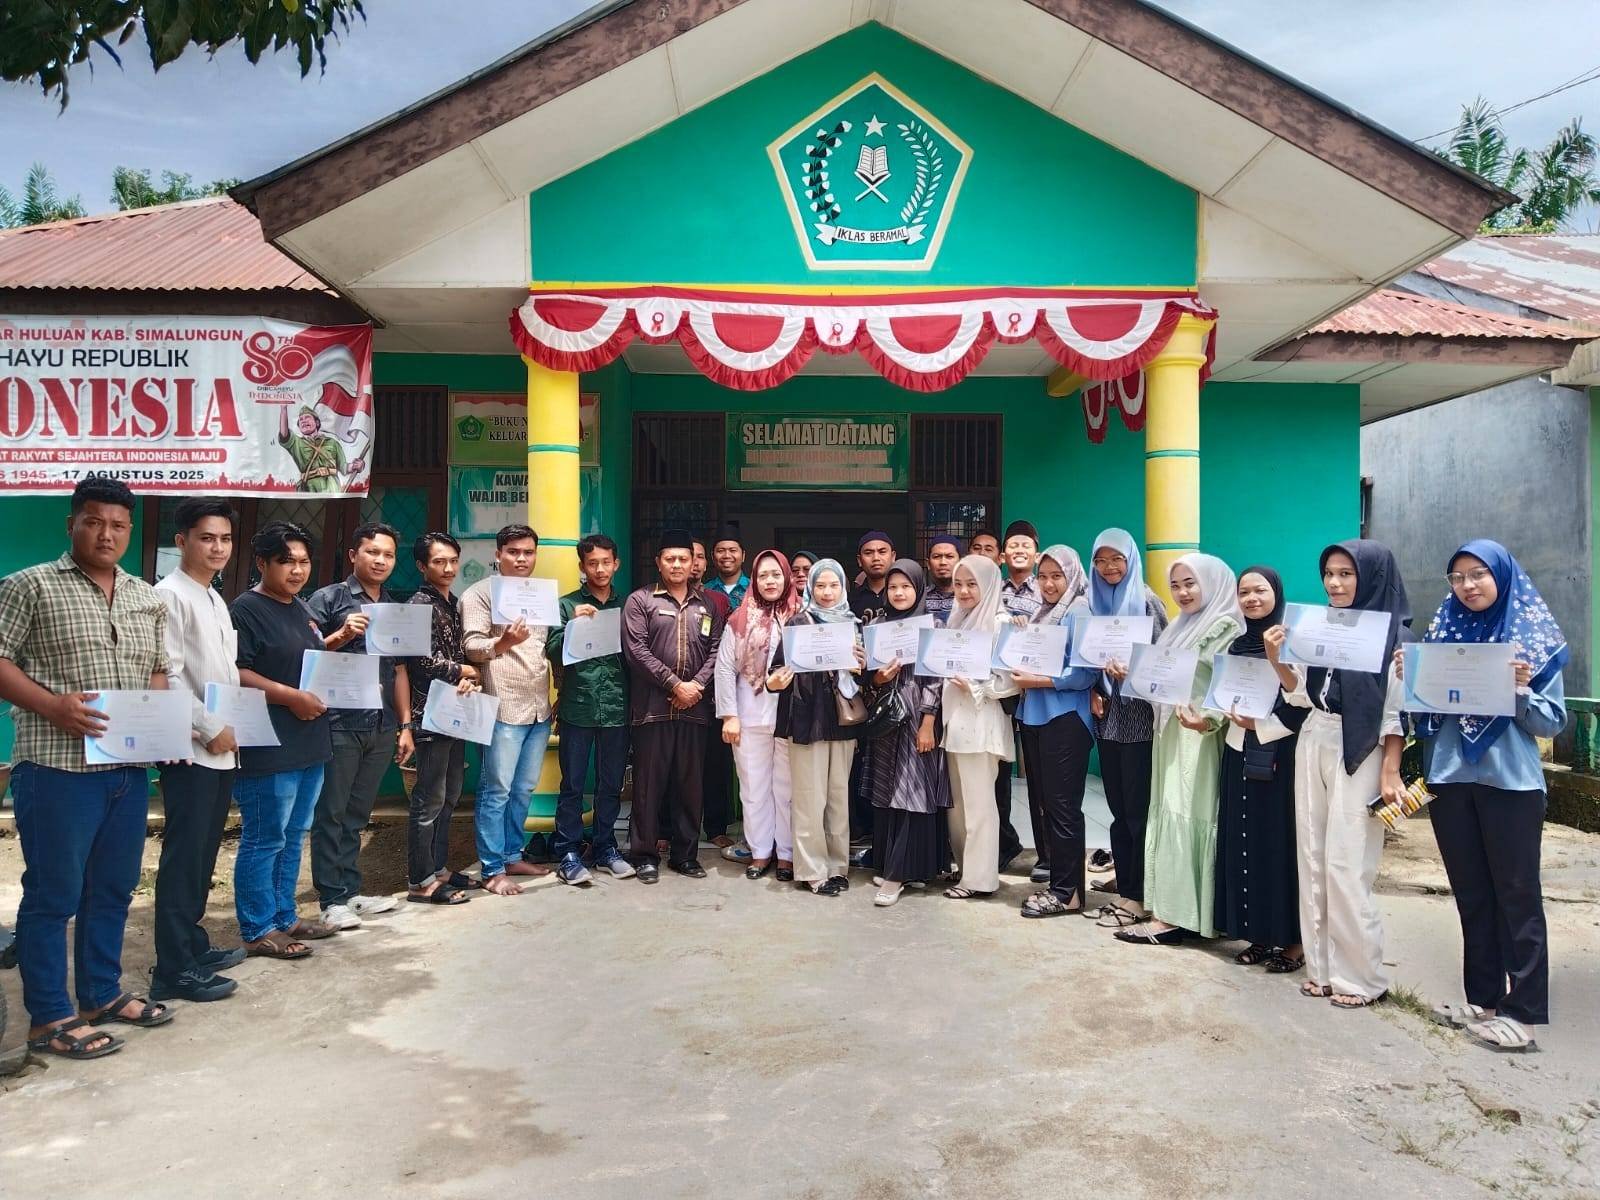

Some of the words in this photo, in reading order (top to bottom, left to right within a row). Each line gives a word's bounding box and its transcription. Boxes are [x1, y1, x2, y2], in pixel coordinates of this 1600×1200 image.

[837, 228, 866, 241] IKLAS
[870, 229, 907, 242] BERAMAL
[19, 328, 86, 341] HULUAN
[91, 329, 130, 341] KAB.
[135, 329, 244, 341] SIMALUNGUN
[277, 336, 293, 344] TH
[0, 348, 64, 368] HAYU
[71, 348, 190, 368] REPUBLIK
[242, 331, 314, 385] 80
[742, 422, 823, 446] SELAMAT
[825, 422, 896, 446] DATANG
[11, 451, 54, 461] RAKYAT
[57, 451, 123, 462] SEJAHTERA
[126, 452, 189, 462] INDONESIA
[191, 451, 220, 462] MAJU
[12, 470, 47, 480] 1945
[62, 470, 80, 480] 17
[86, 470, 164, 480] AGUSTUS
[169, 470, 204, 480] 2025
[469, 490, 507, 503] WAJIB
